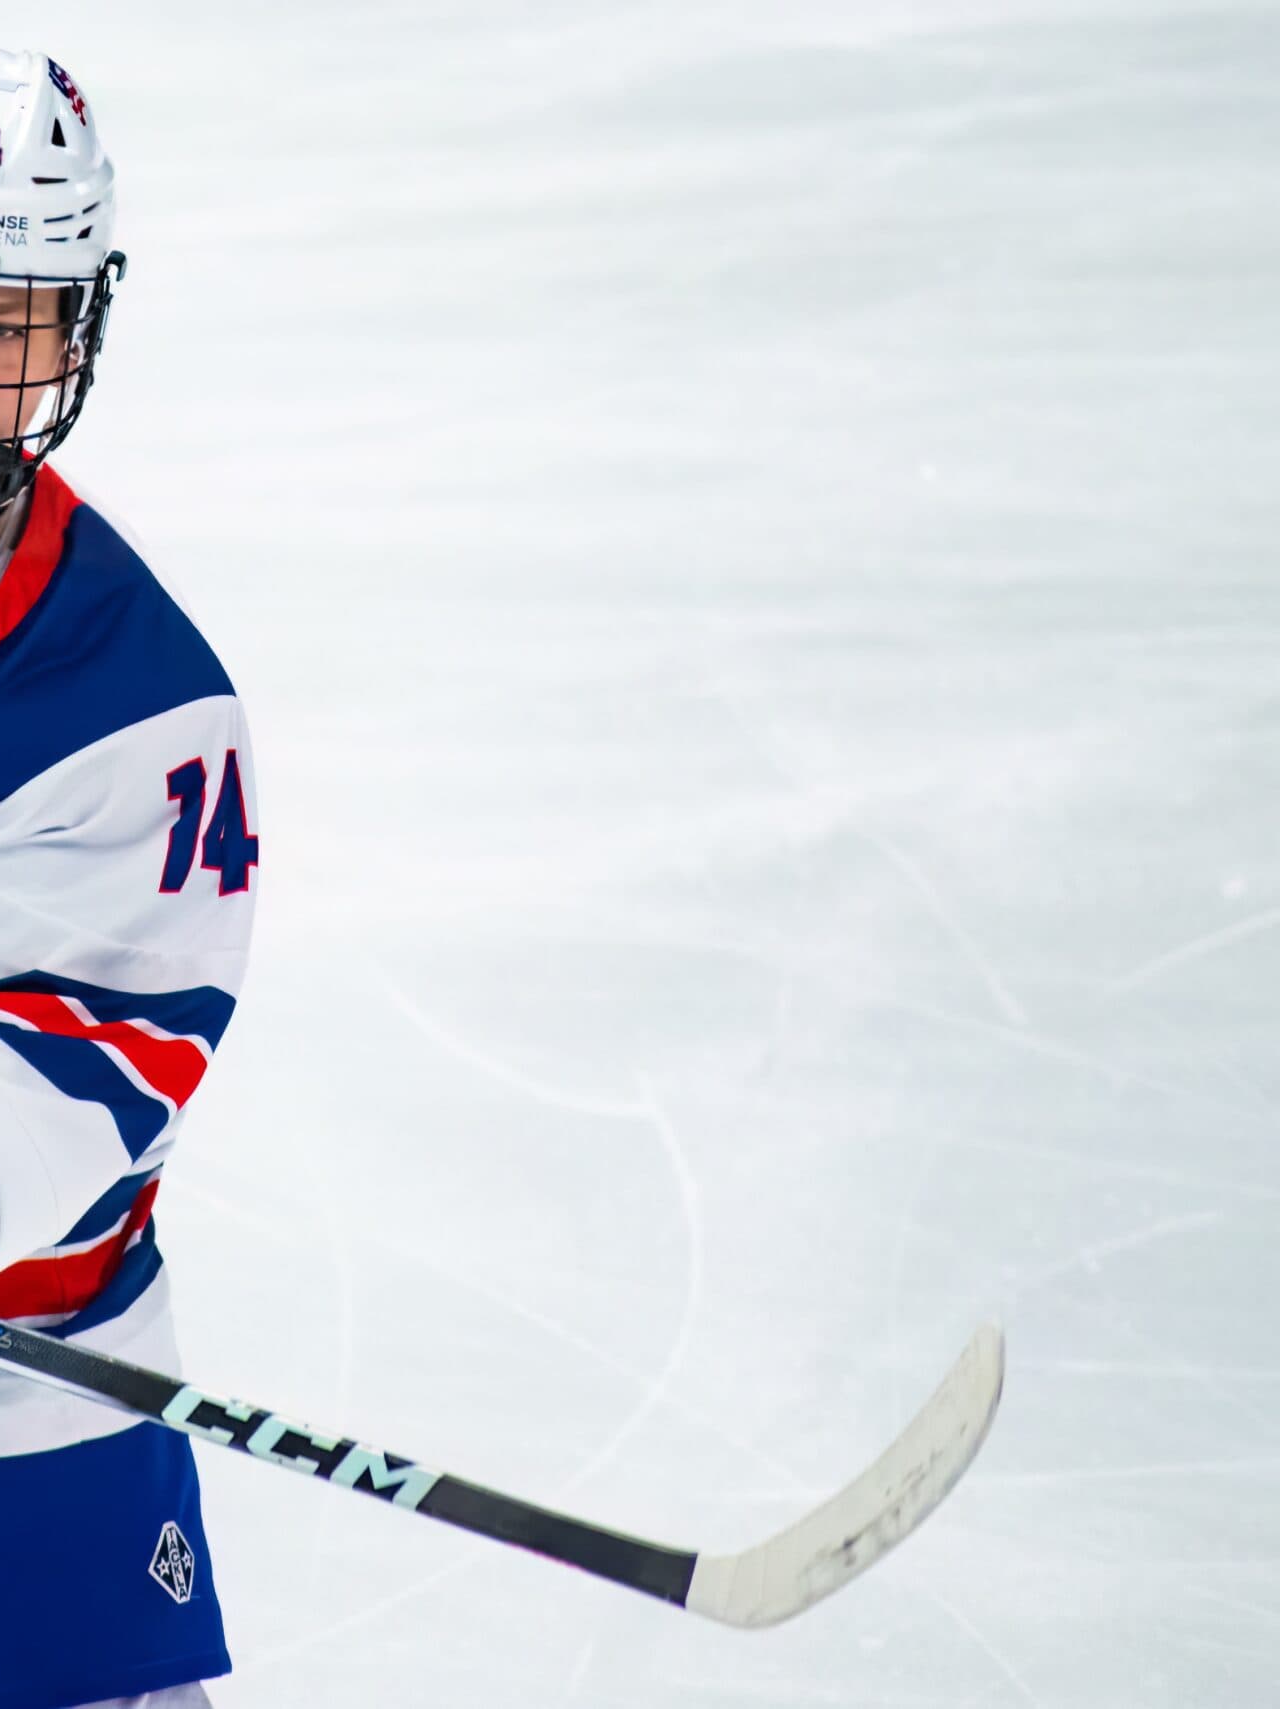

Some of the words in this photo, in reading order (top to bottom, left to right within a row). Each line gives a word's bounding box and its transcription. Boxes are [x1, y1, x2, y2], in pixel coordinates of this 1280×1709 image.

[158, 748, 260, 898] 14
[161, 1383, 447, 1513] CCM
[166, 1525, 189, 1601] TACKLA
